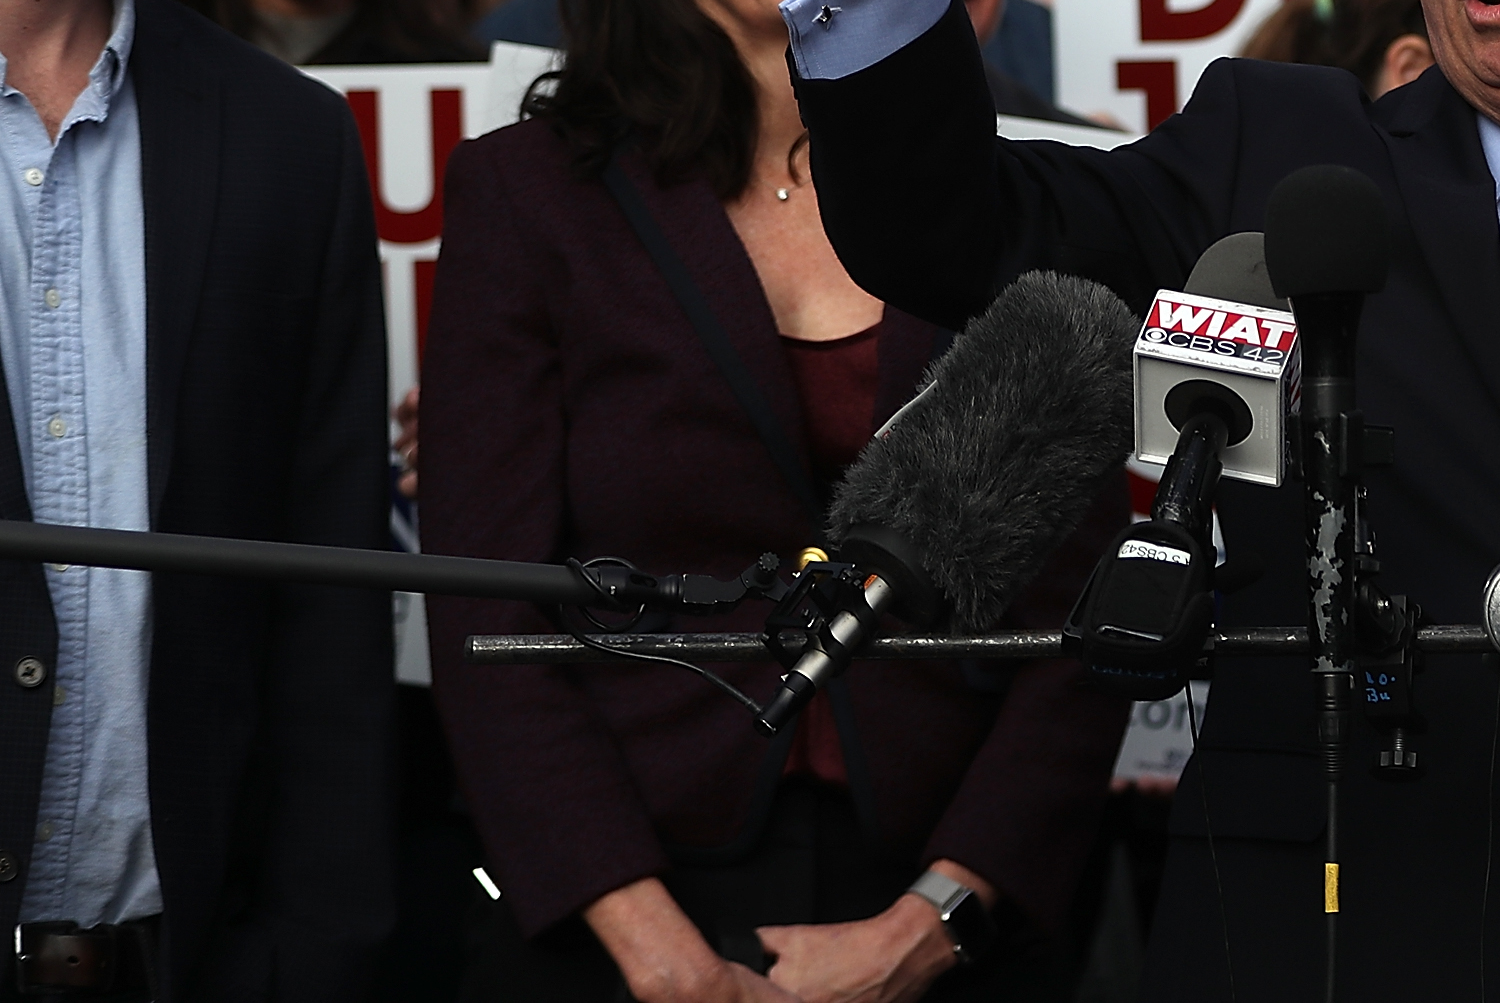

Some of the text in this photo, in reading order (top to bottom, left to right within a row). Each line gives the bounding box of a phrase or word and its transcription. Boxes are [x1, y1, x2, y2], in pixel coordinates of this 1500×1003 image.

[1158, 300, 1296, 348] WIAT
[1168, 332, 1285, 365] CBS 42
